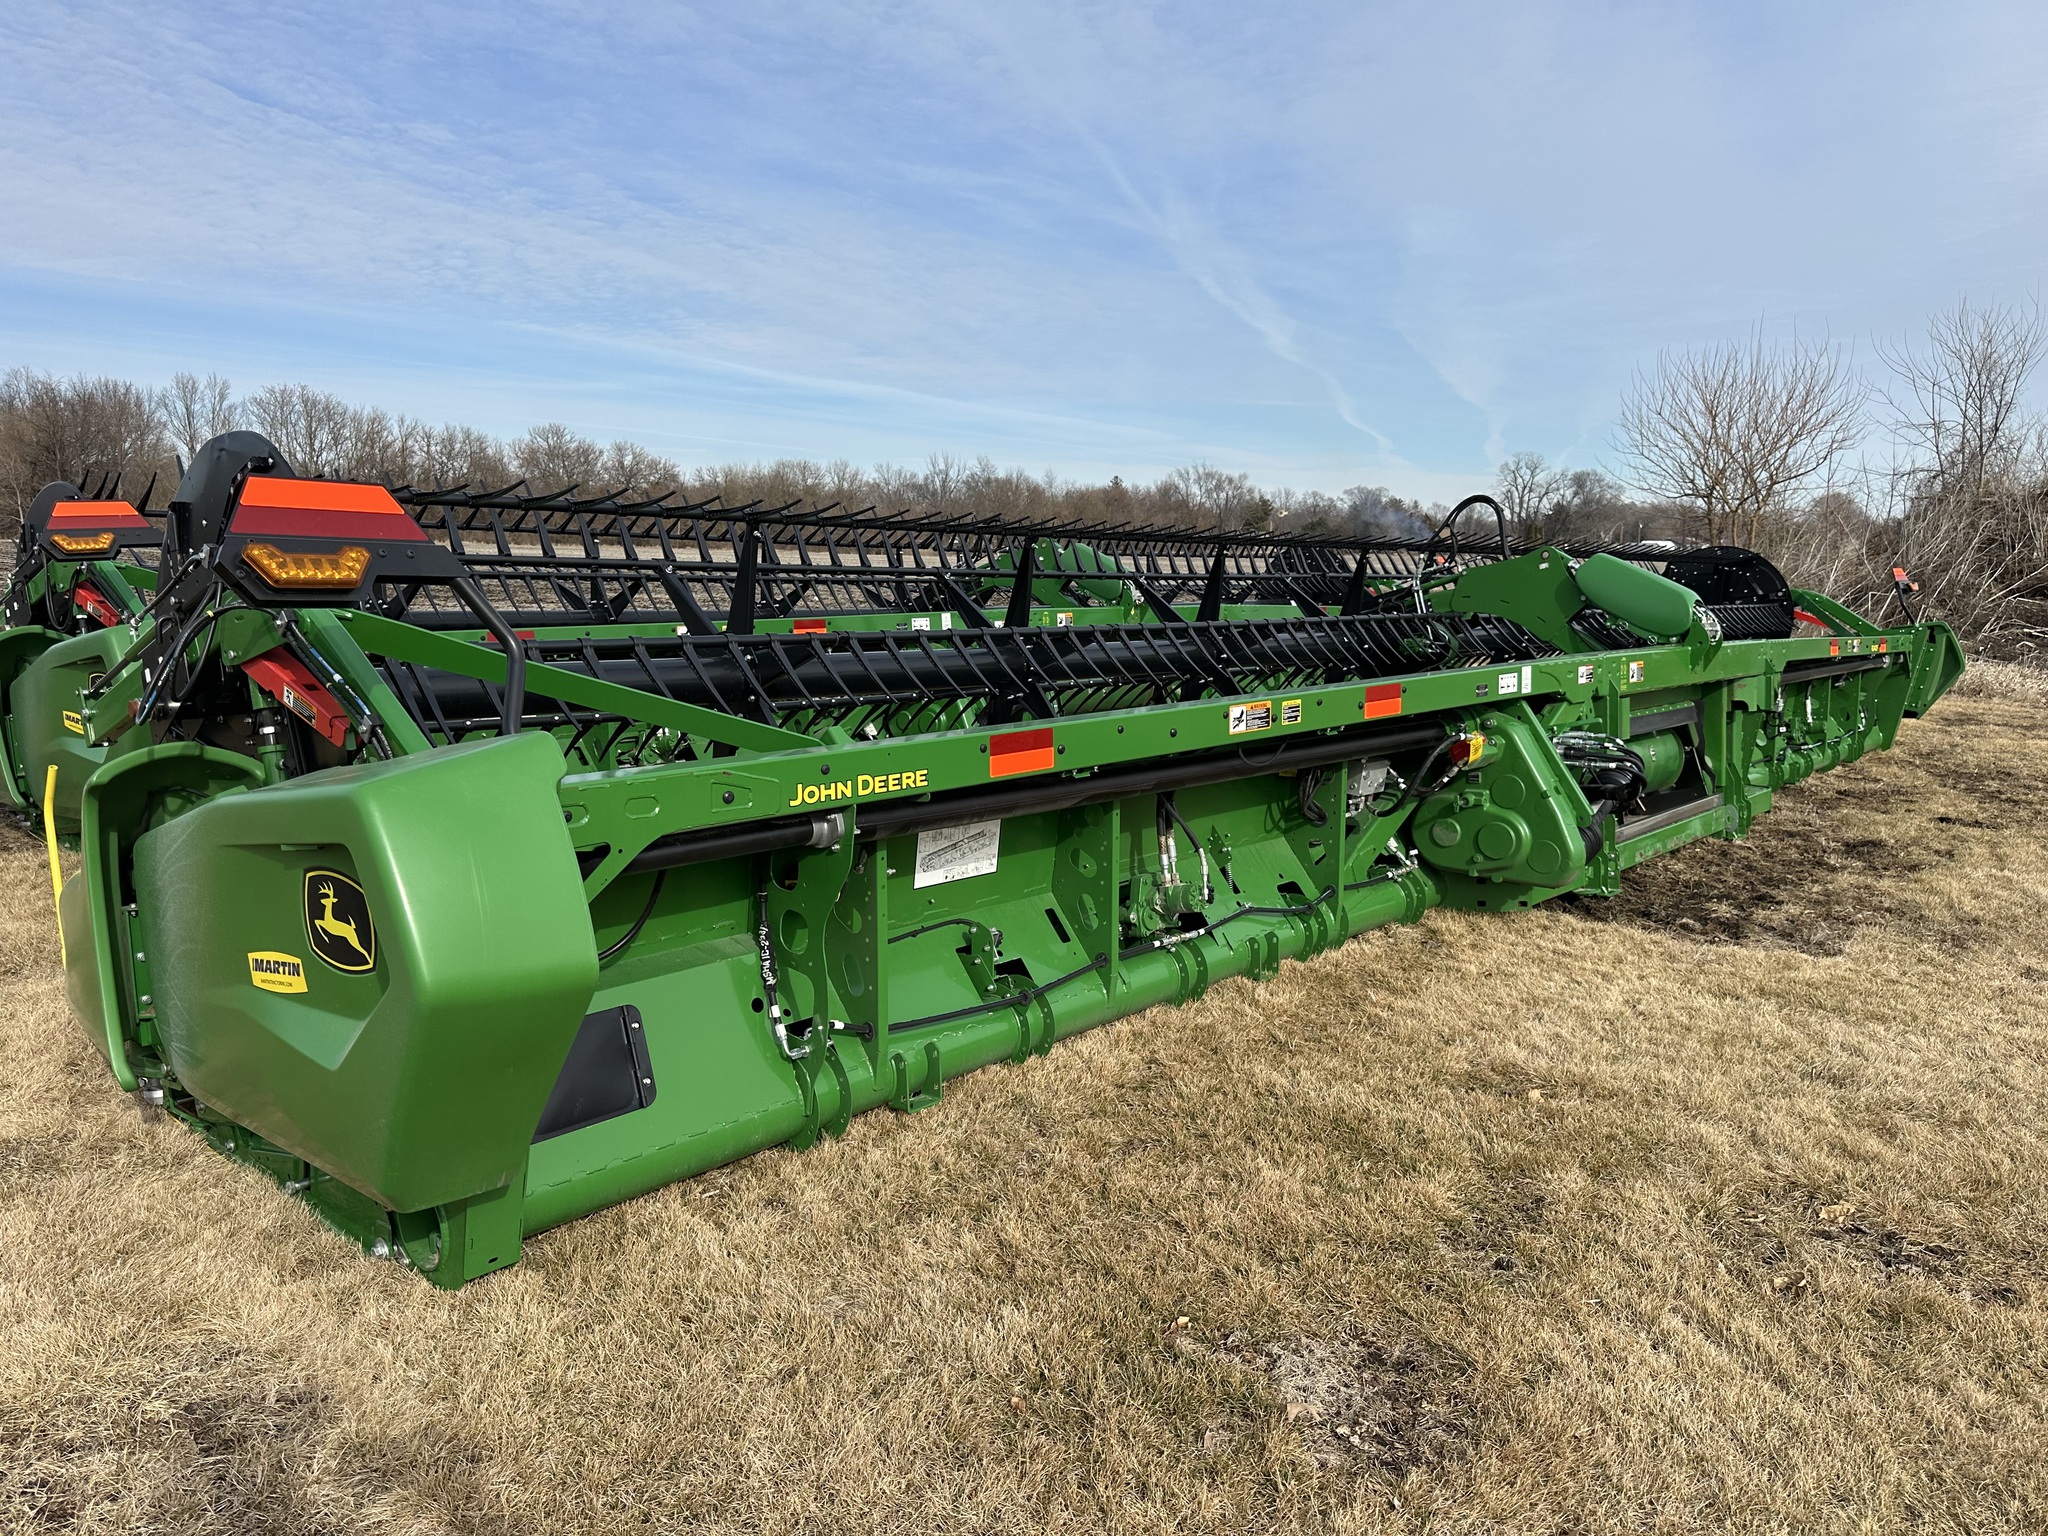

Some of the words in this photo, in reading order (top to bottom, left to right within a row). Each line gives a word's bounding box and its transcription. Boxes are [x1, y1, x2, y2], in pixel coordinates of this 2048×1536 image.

[789, 780, 852, 807] JOHN
[857, 769, 928, 796] DEERE
[252, 958, 301, 977] MARTIN
[762, 959, 777, 986] MSHA
